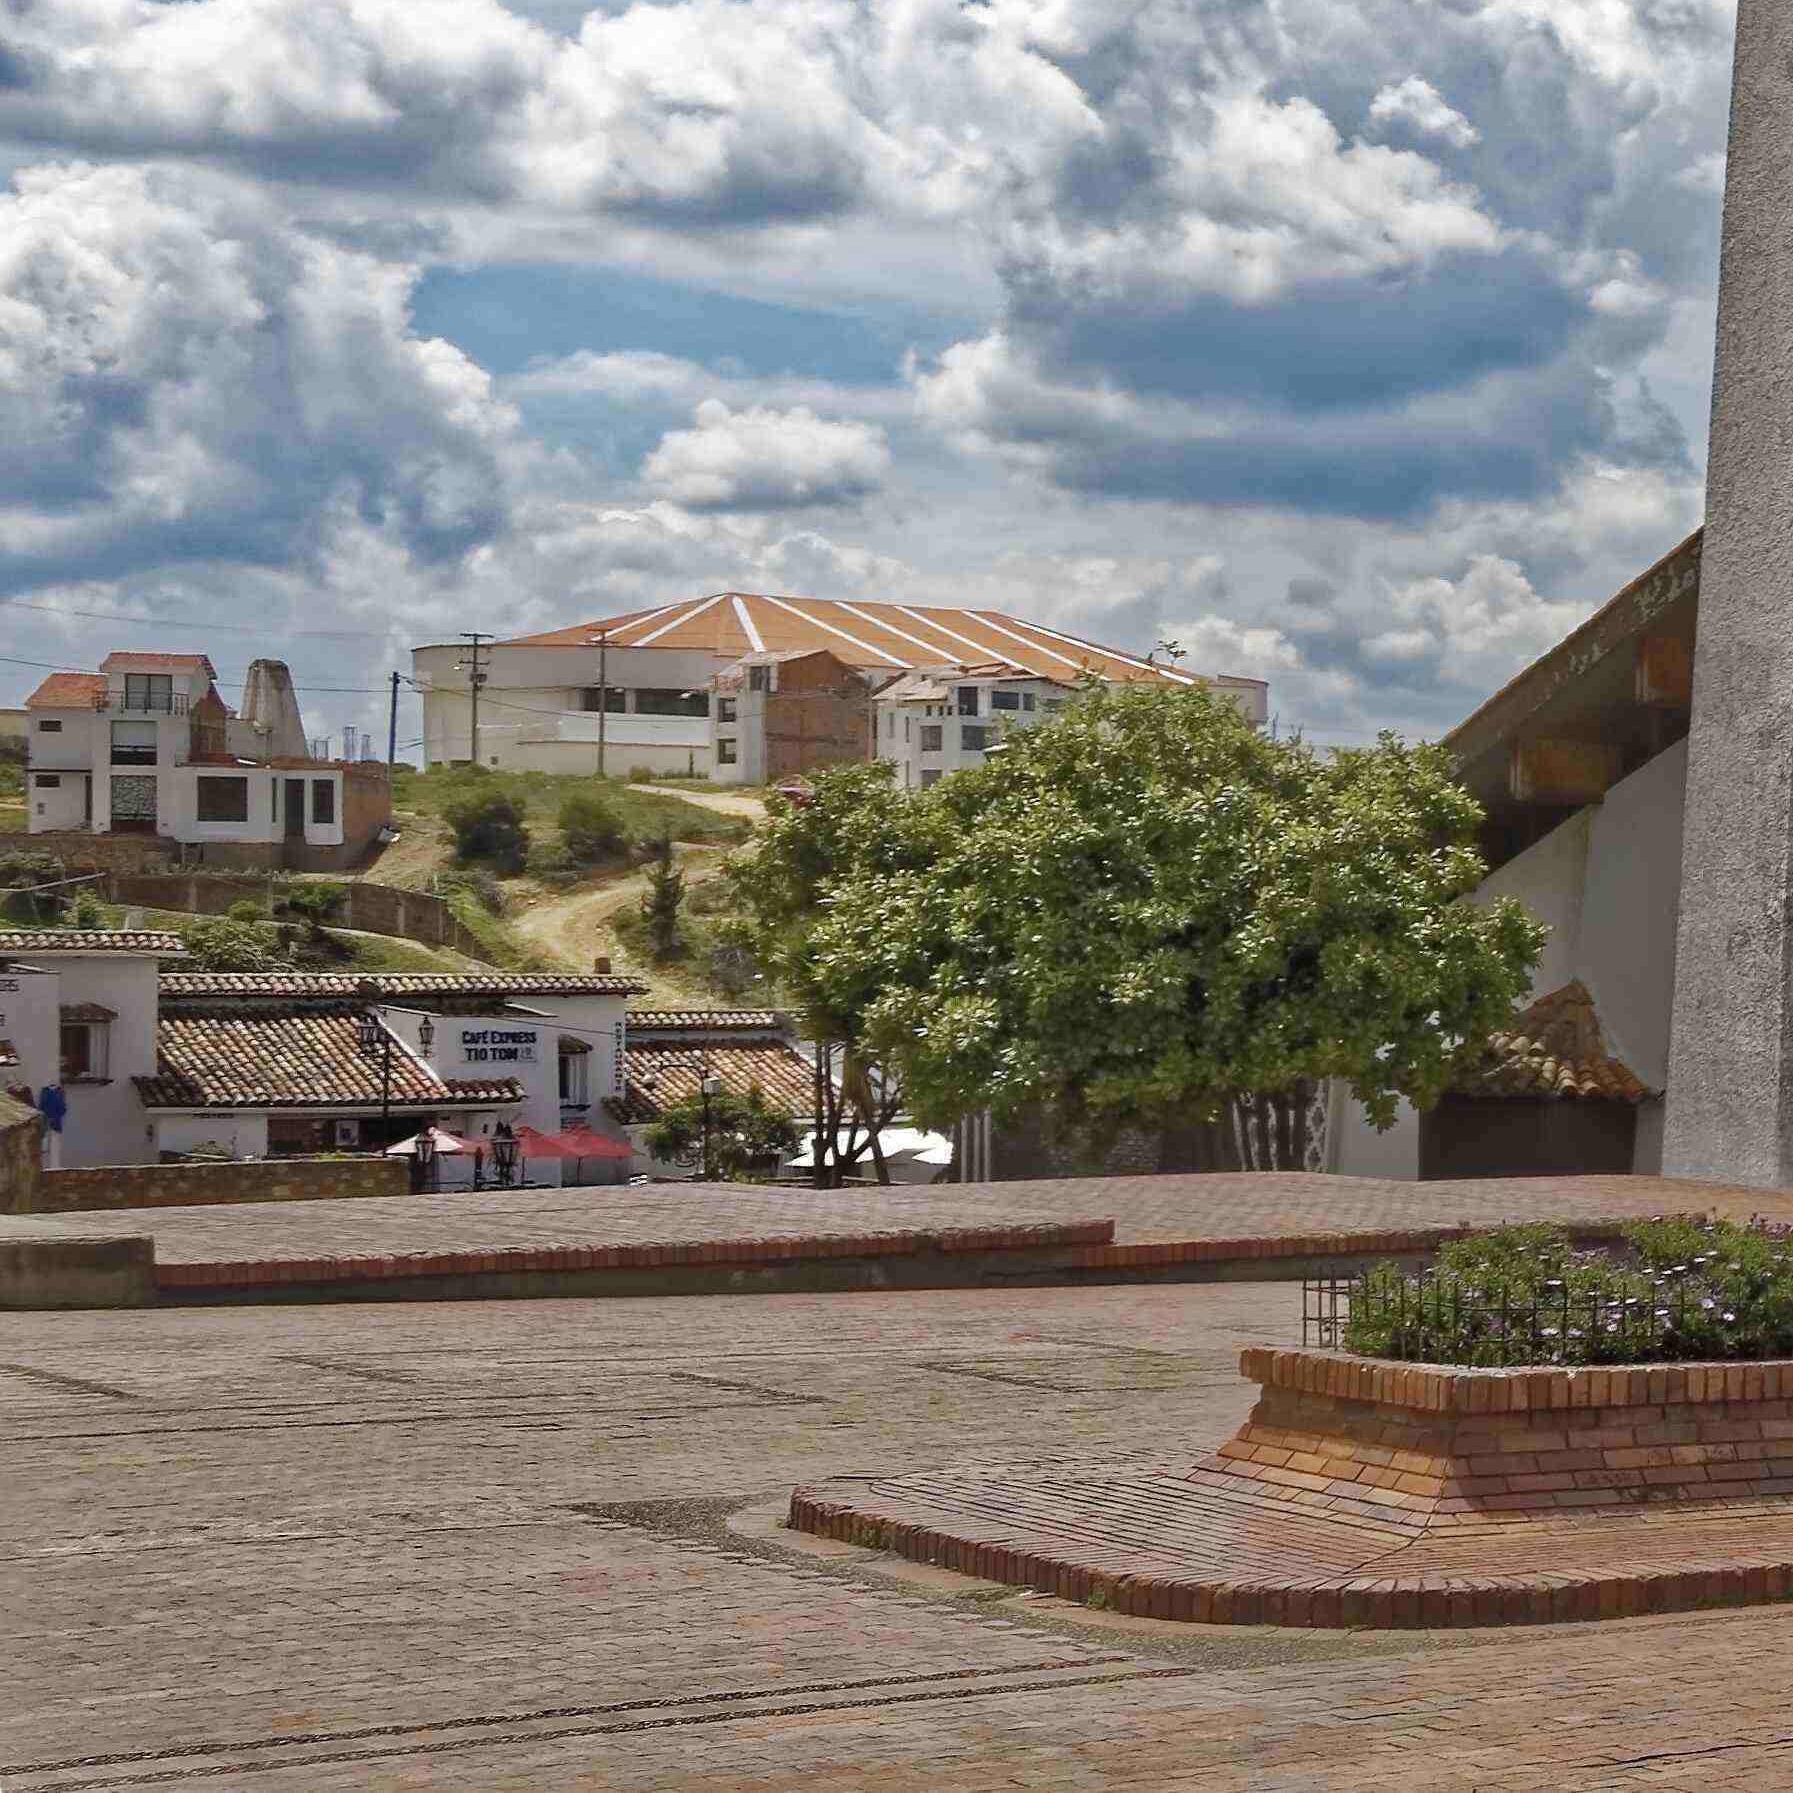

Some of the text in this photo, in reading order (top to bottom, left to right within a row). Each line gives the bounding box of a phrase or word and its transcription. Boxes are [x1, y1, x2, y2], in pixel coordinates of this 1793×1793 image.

[462, 1029, 537, 1045] CAFÉ EXPRESS
[464, 1047, 488, 1062] TIO
